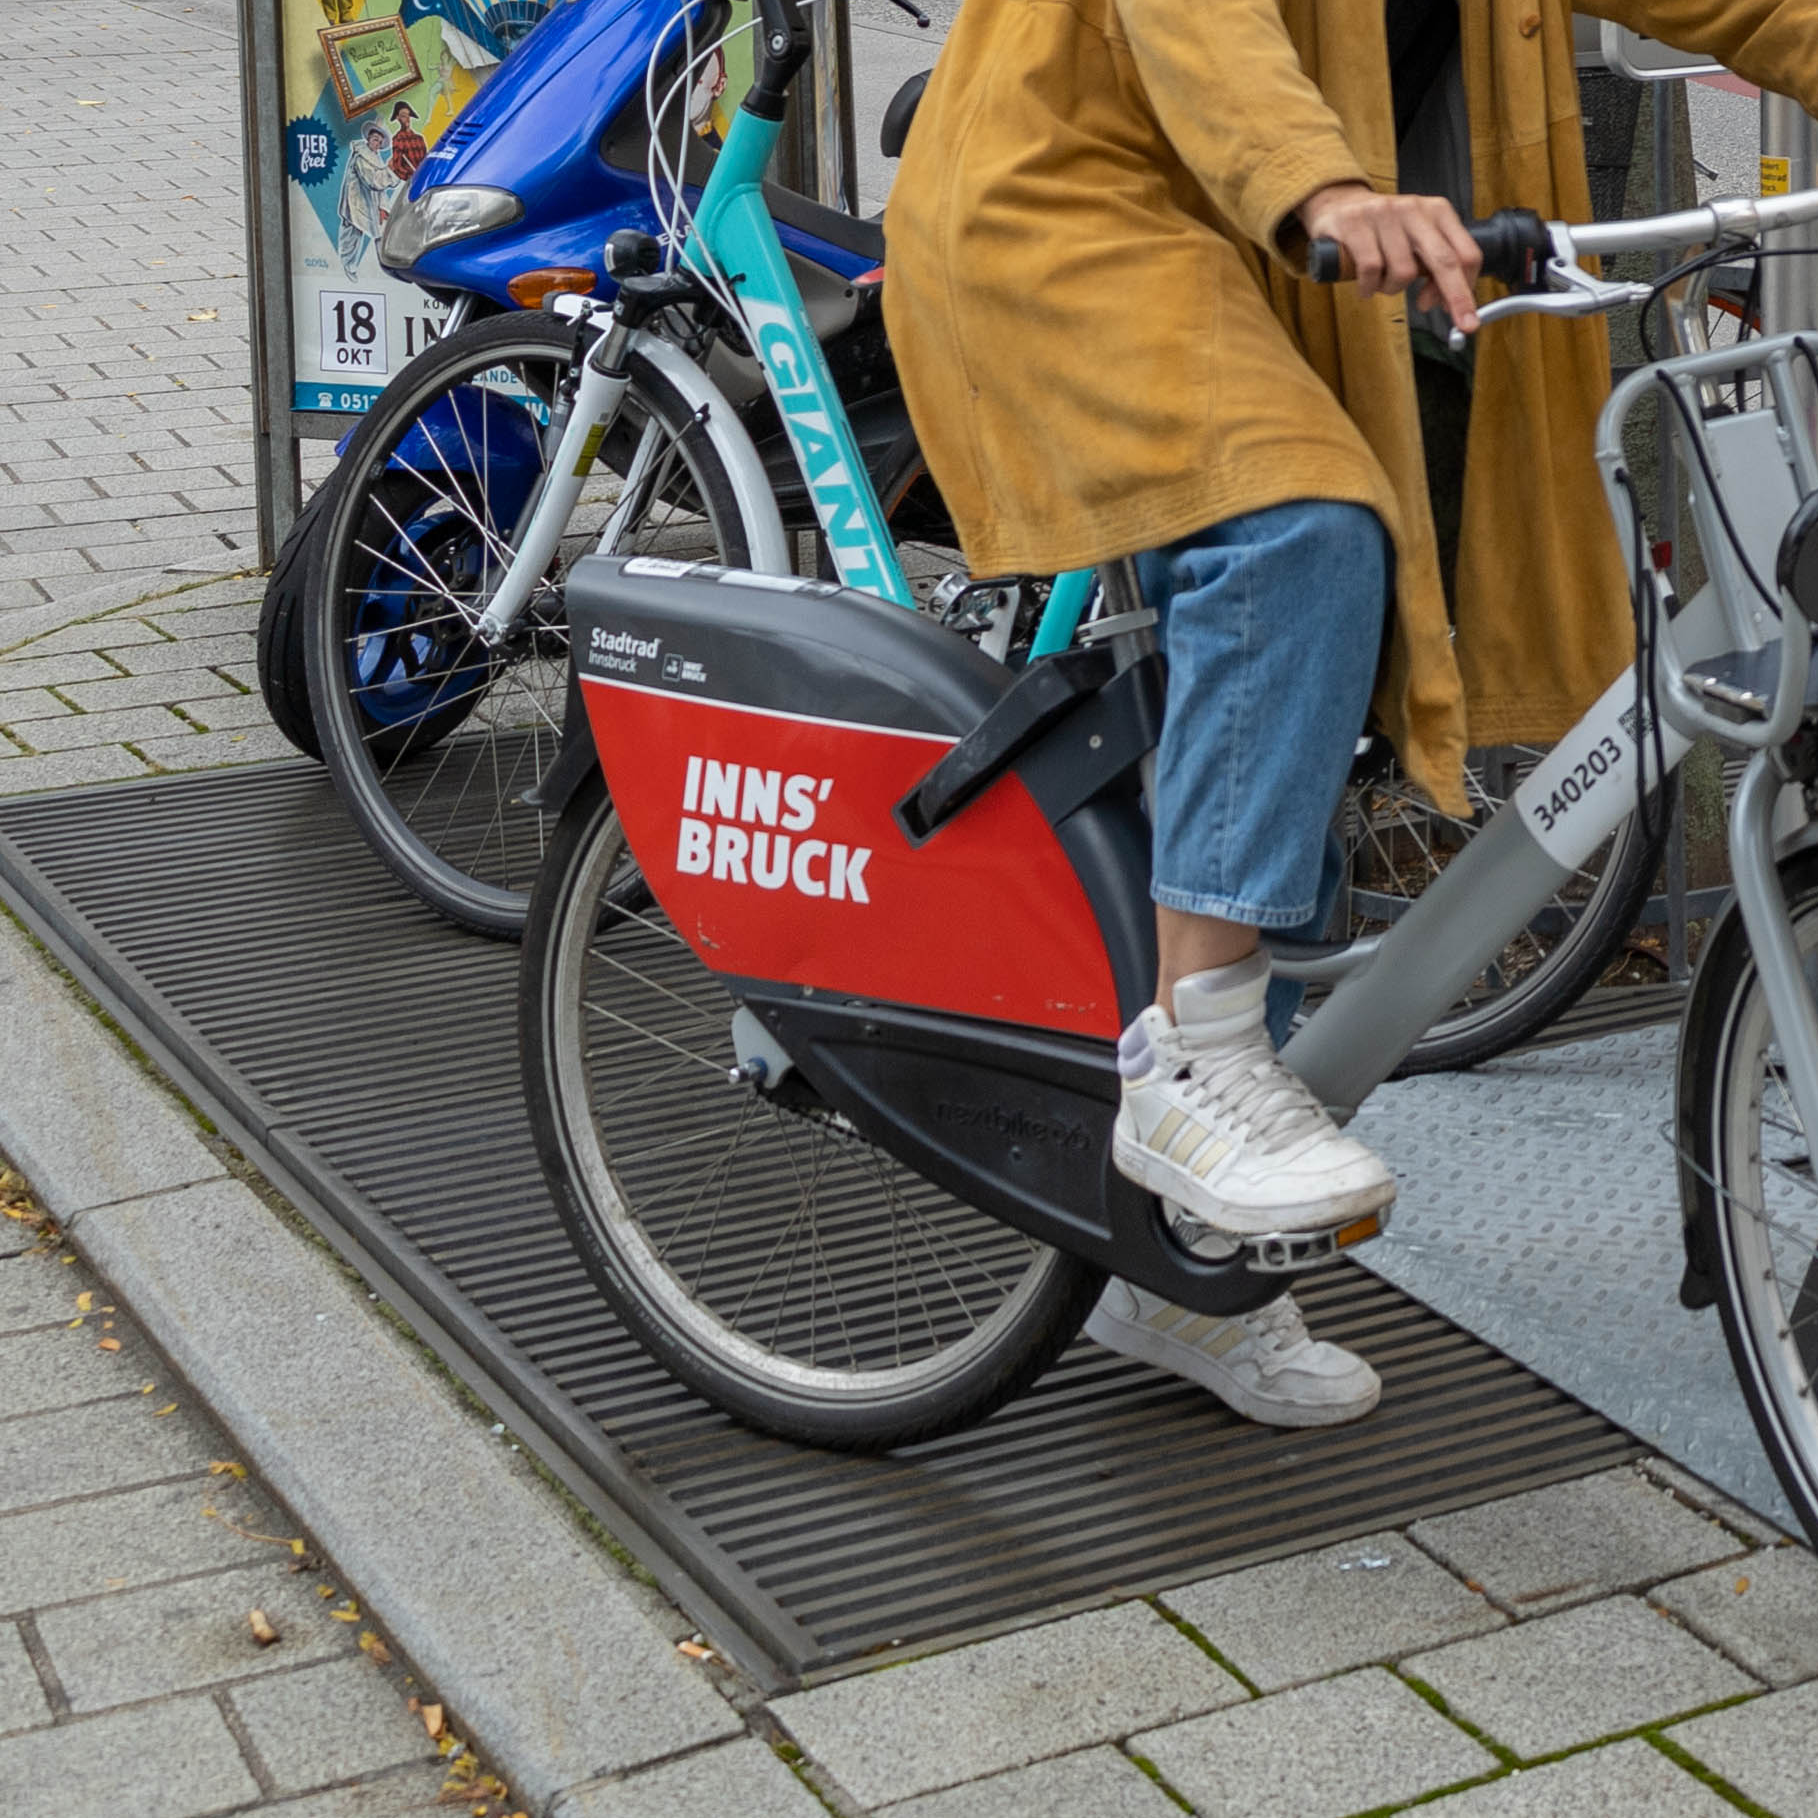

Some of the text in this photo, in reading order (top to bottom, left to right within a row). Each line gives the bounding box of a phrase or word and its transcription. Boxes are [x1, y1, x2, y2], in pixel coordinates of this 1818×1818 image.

[297, 134, 329, 153] TIER
[300, 149, 328, 174] frei
[332, 299, 377, 345] 18
[336, 347, 373, 366] OKT
[757, 320, 896, 598] GIANT
[588, 649, 637, 673] Innsbruck
[590, 627, 660, 659] Stadtrad
[682, 755, 835, 832] INNS'
[1534, 735, 1622, 833] 340203
[676, 816, 873, 905] BRUCK
